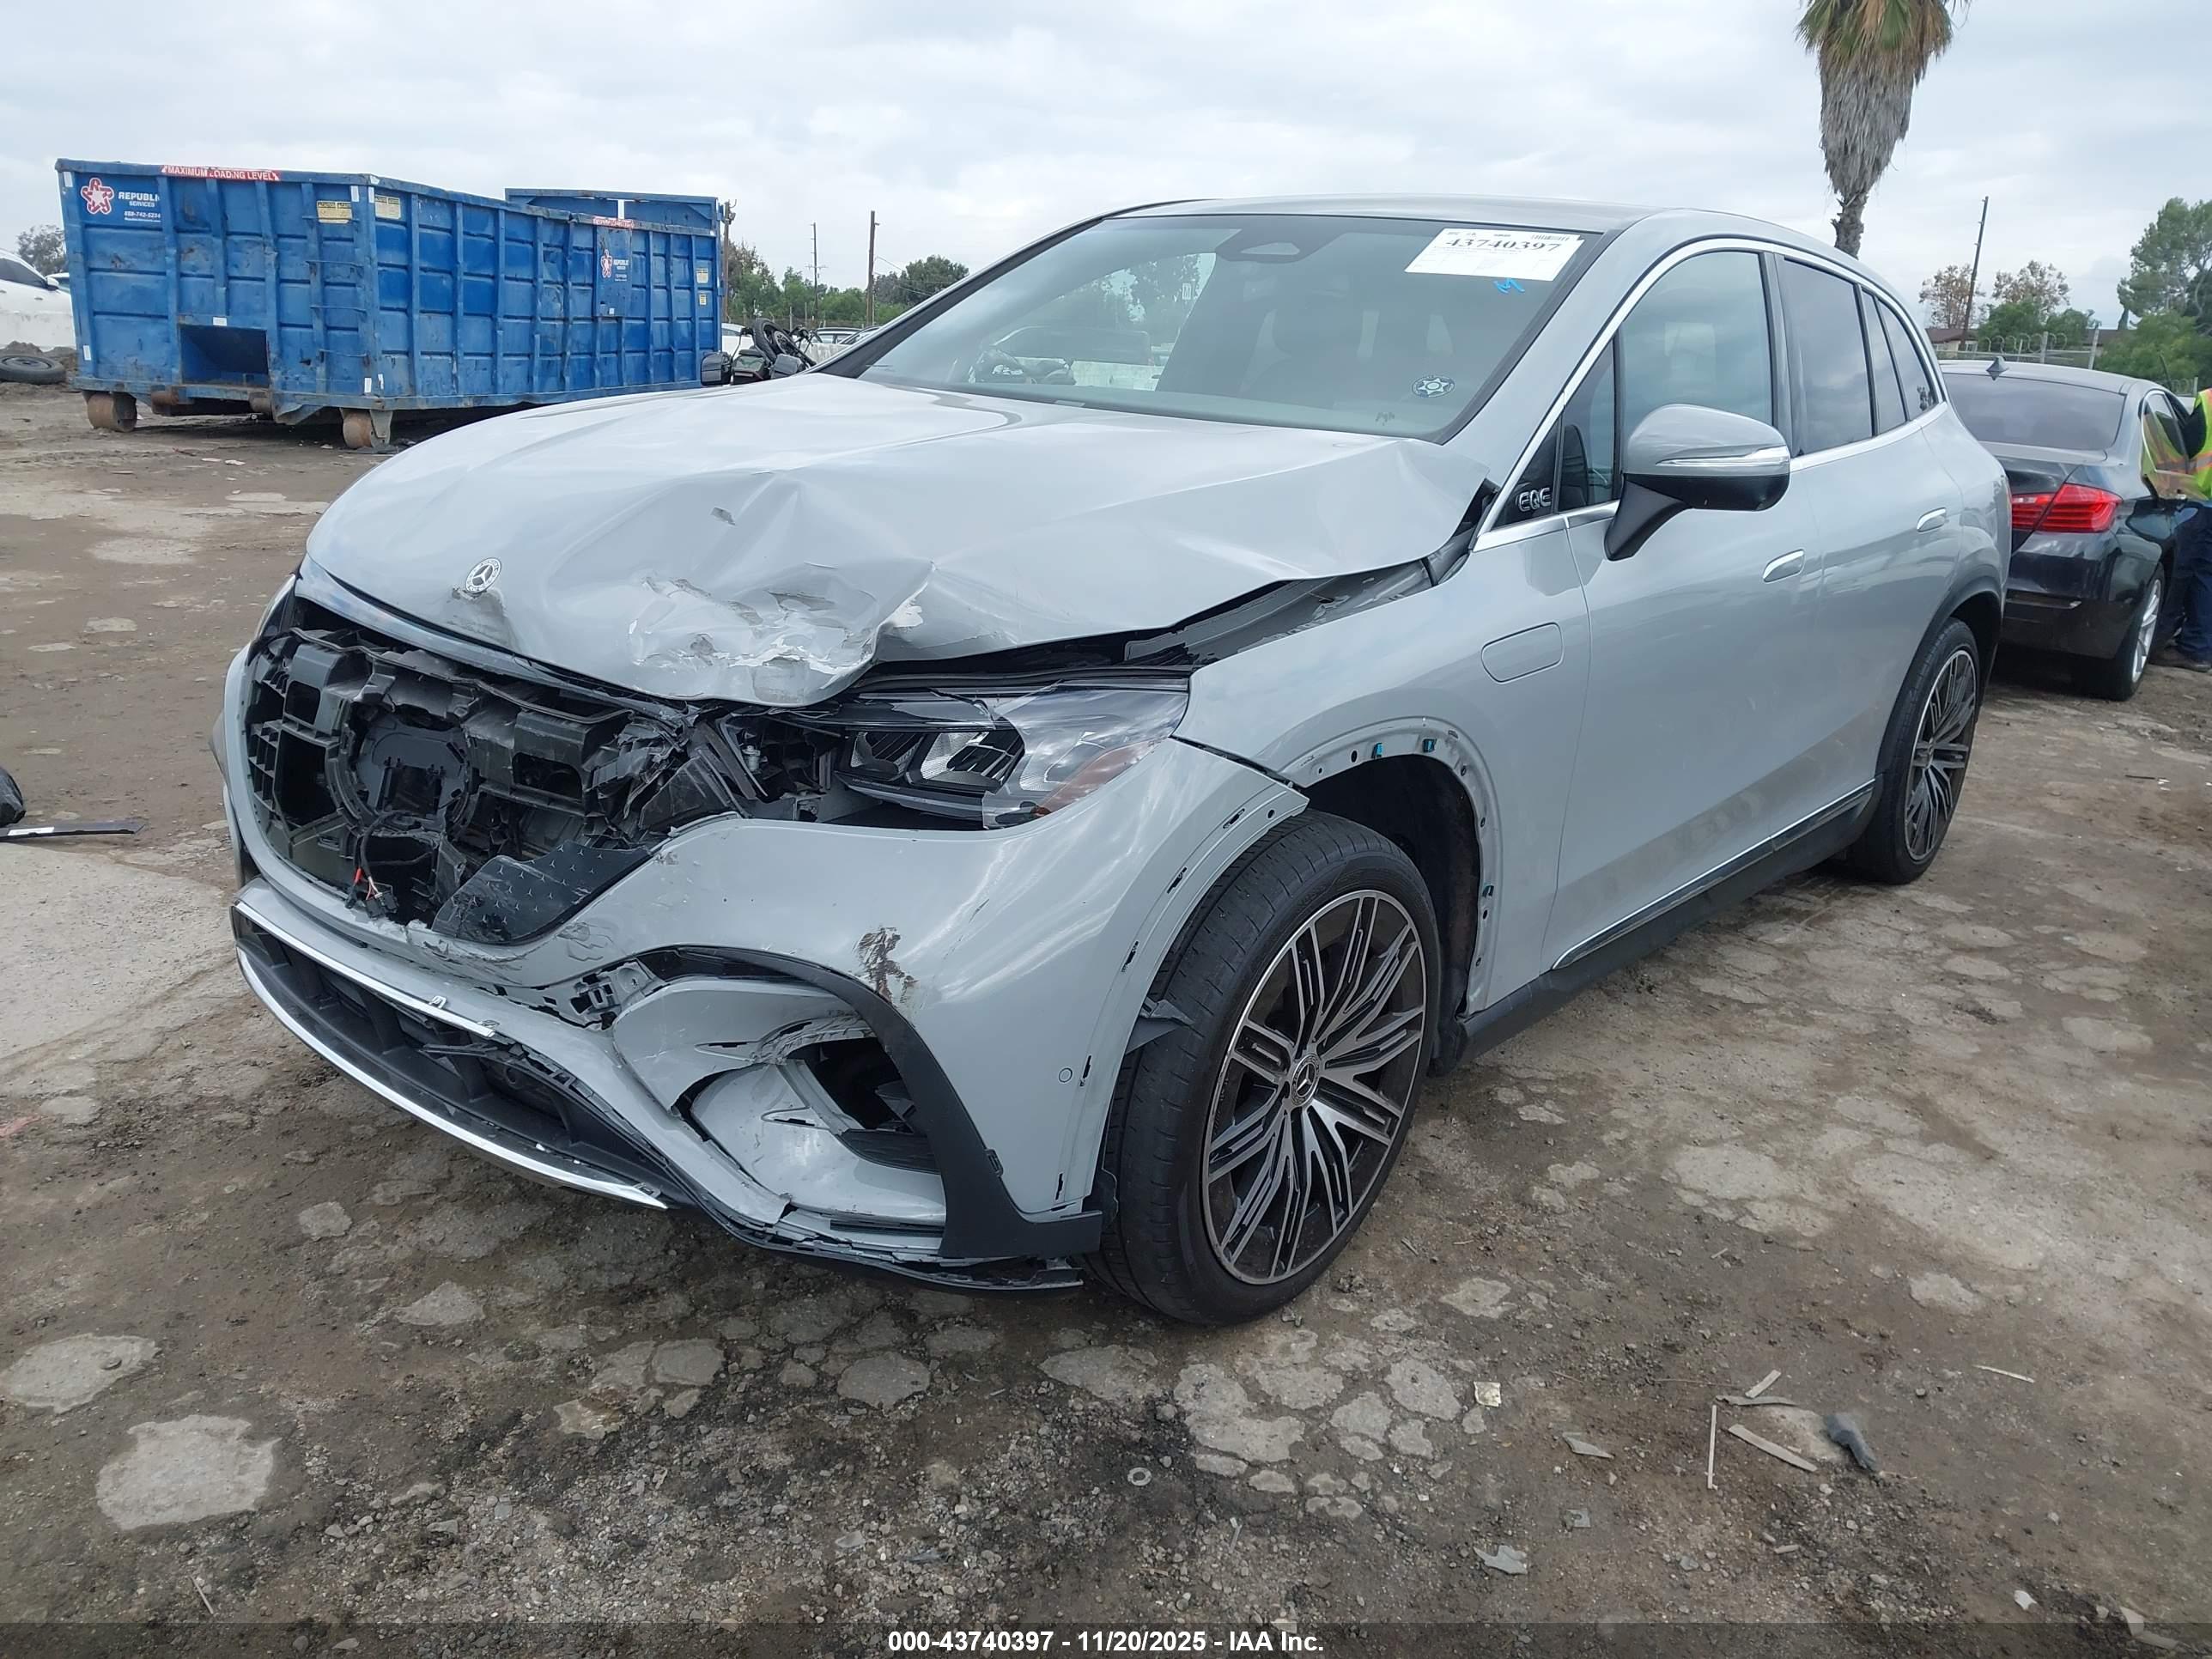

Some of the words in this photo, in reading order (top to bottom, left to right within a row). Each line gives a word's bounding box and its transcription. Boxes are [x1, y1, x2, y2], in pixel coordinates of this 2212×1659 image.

[167, 167, 208, 177] MAXIMUM
[246, 170, 275, 180] LEVEL
[1446, 238, 1561, 252] 43740397
[1519, 487, 1552, 512] EQE
